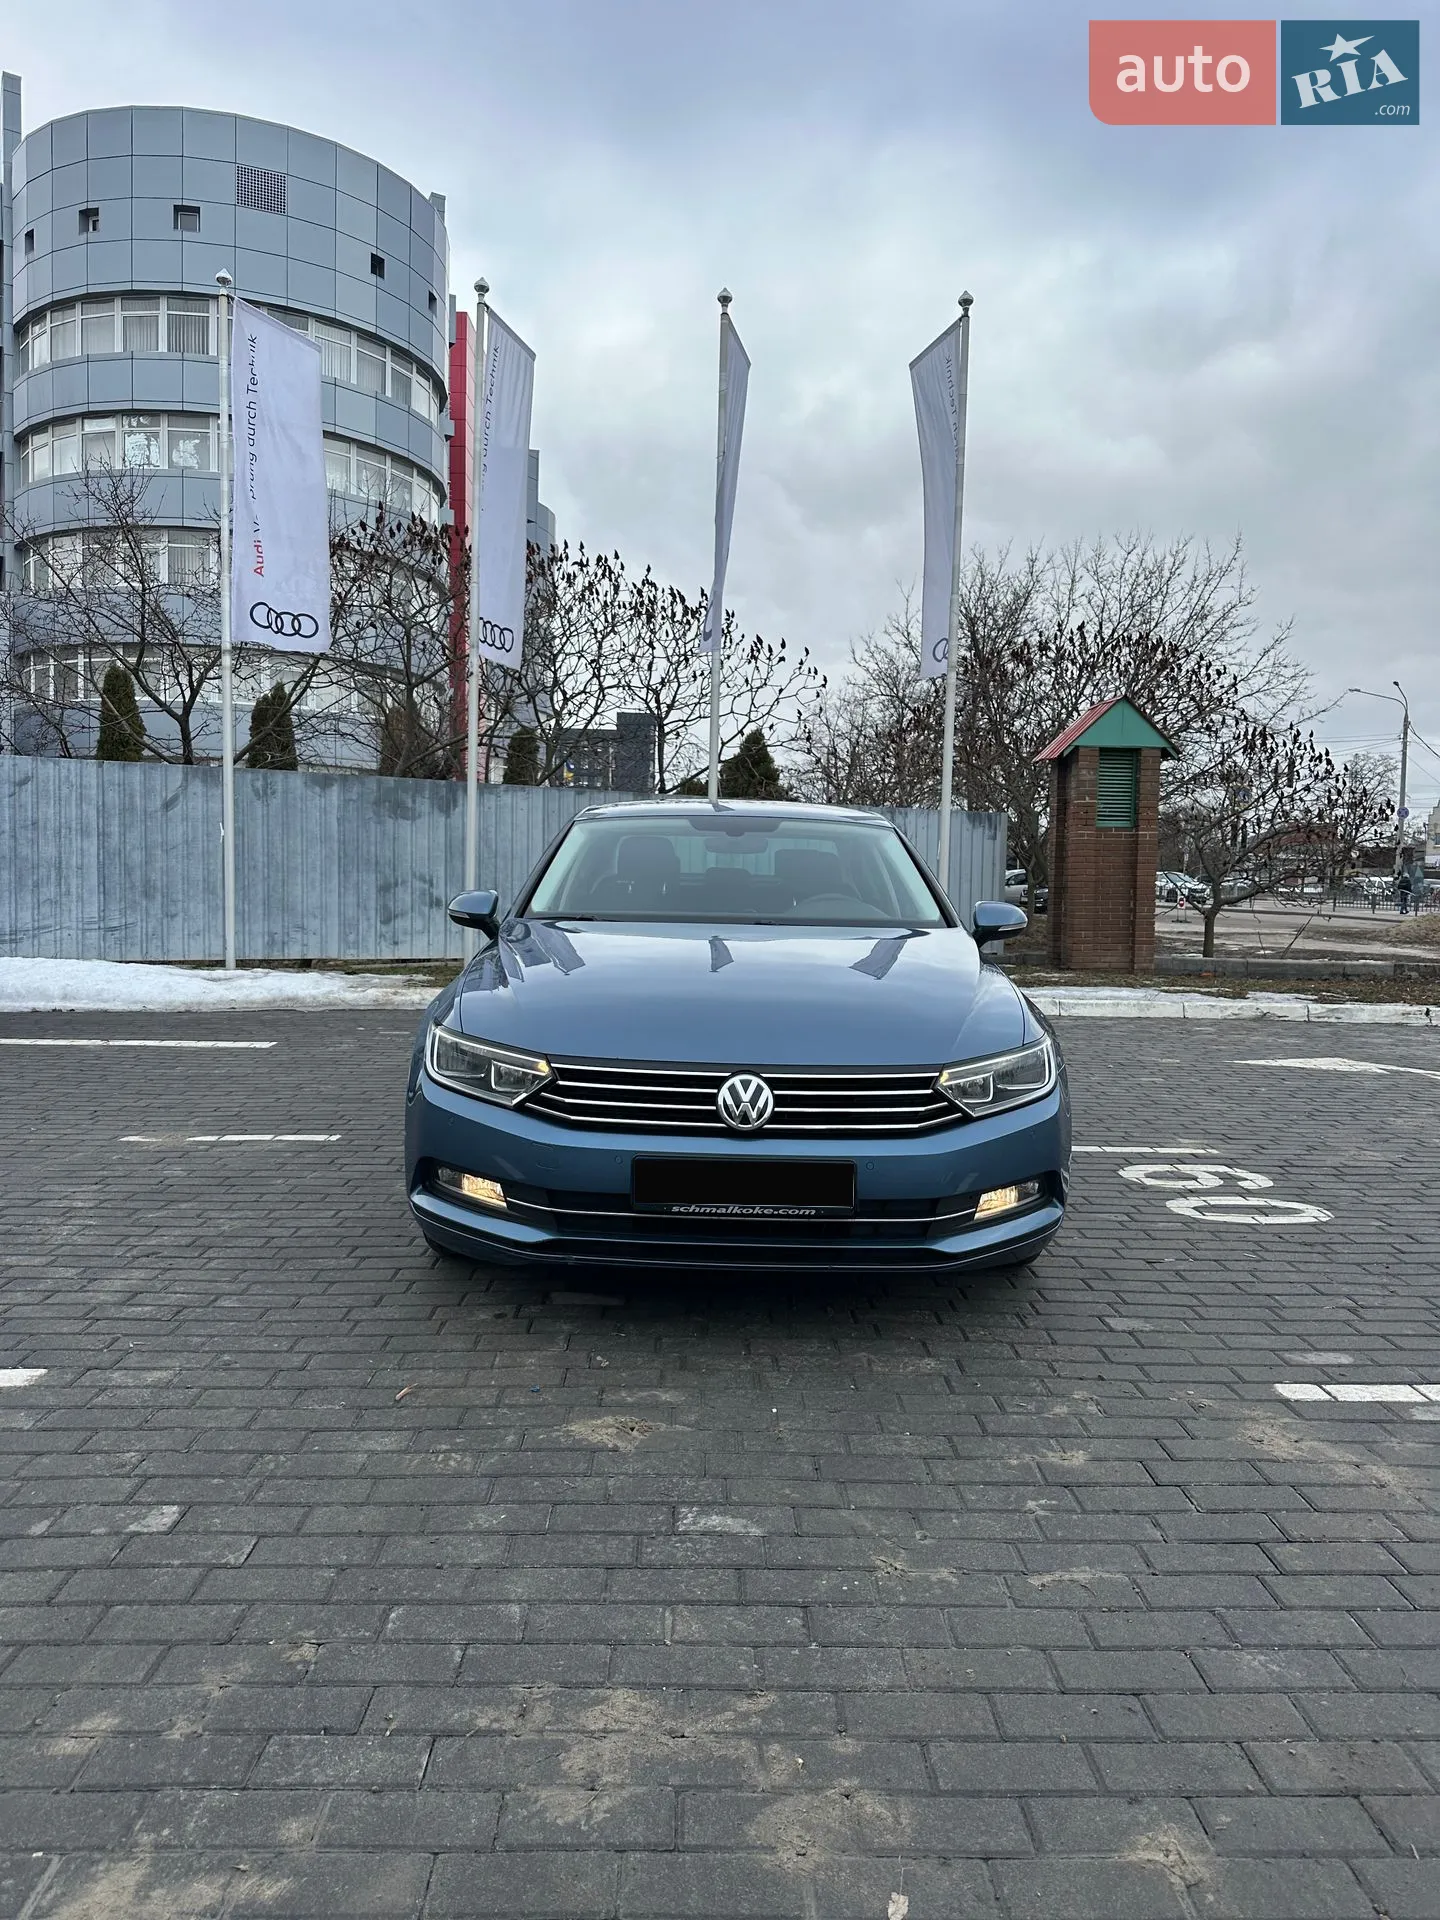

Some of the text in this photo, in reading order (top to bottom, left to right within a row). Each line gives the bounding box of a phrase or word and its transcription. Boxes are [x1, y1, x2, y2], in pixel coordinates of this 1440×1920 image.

[485, 344, 500, 406] Technik
[245, 400, 257, 448] durch
[253, 539, 265, 578] Audi
[671, 1204, 816, 1216] schmalkoke.com
